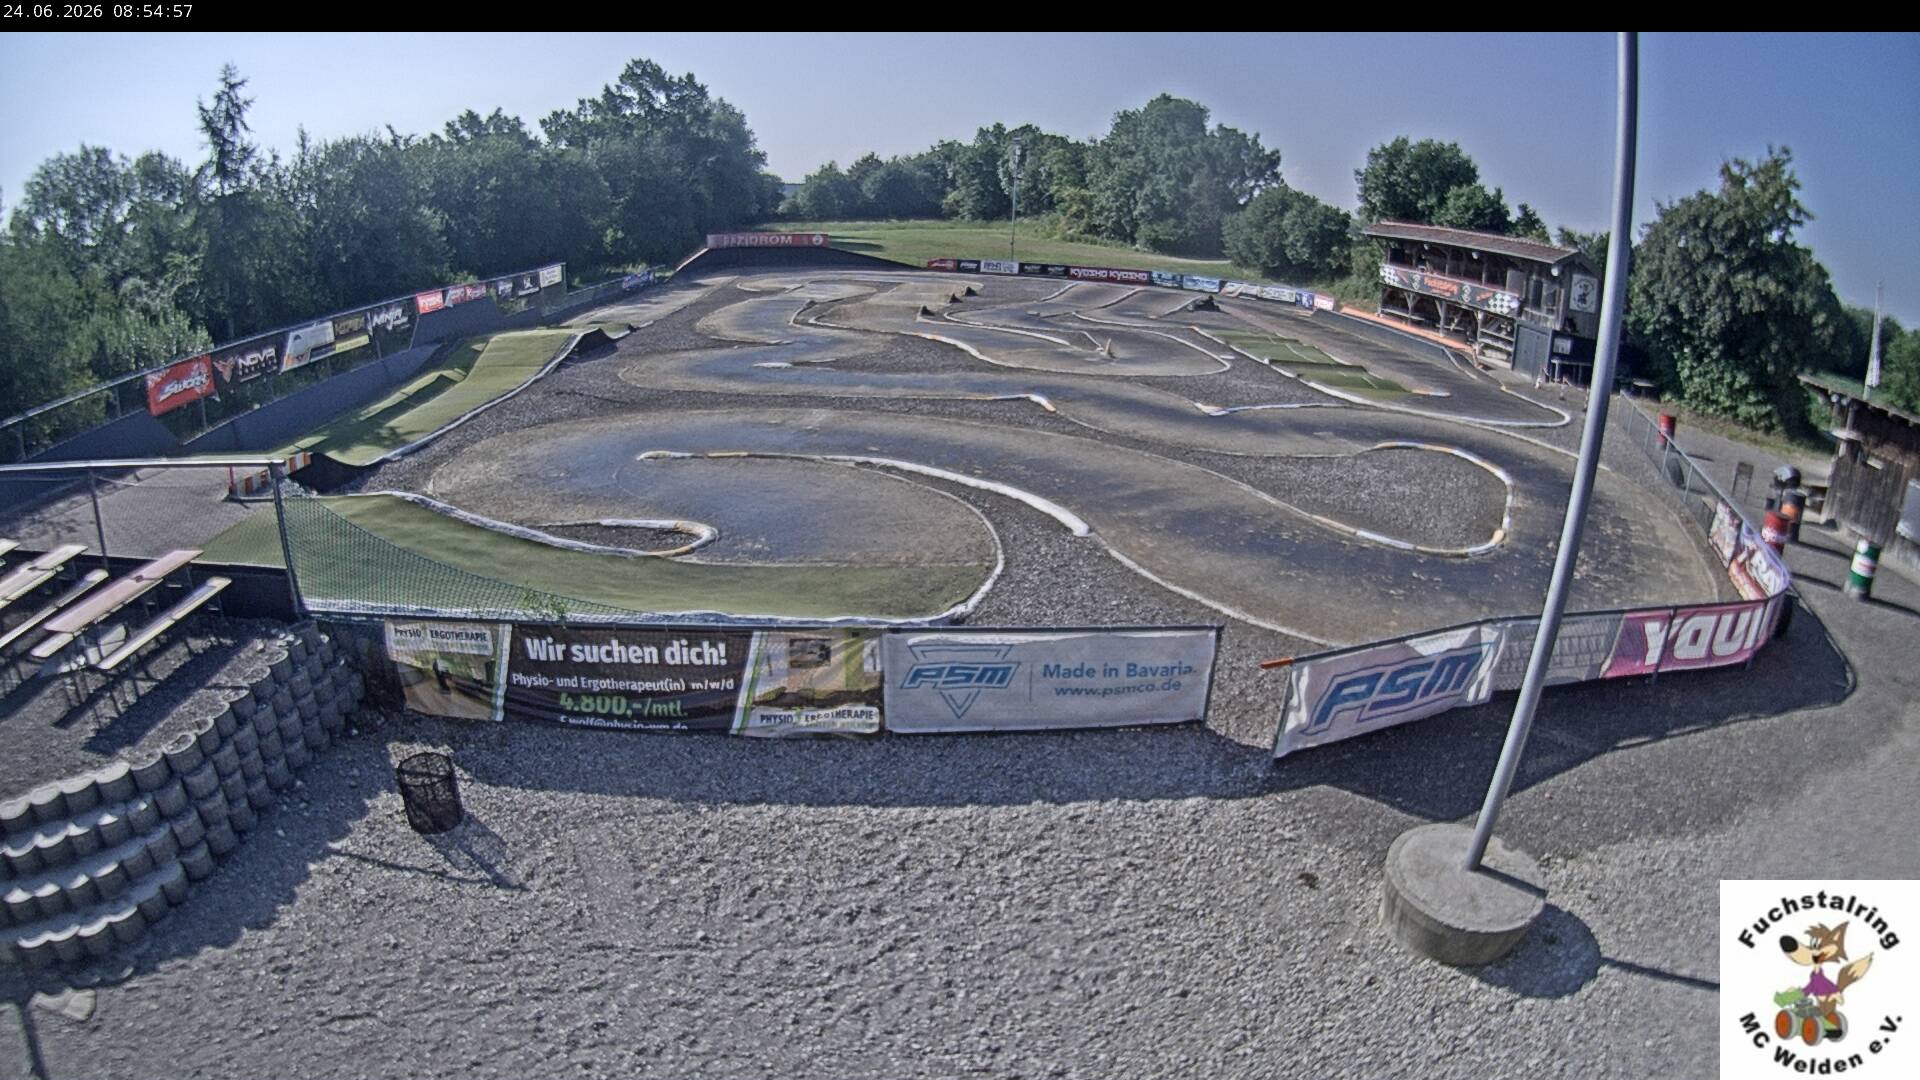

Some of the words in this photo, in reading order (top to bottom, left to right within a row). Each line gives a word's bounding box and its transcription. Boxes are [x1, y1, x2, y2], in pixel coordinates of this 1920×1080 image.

[238, 347, 276, 369] NOVA
[525, 637, 566, 662] Wir
[571, 639, 660, 665] suchen
[664, 638, 728, 666] dich!
[904, 662, 1017, 688] PSM
[1042, 662, 1096, 679] Made
[1103, 661, 1121, 678] in
[512, 673, 554, 688] Physio-
[556, 675, 579, 688] und
[580, 676, 686, 694] Ergotherapeut(in)
[690, 678, 735, 691] m/w/d
[1054, 678, 1182, 699] www.psmco.de
[1306, 644, 1489, 734] PSM
[760, 713, 794, 725] PHYSIO
